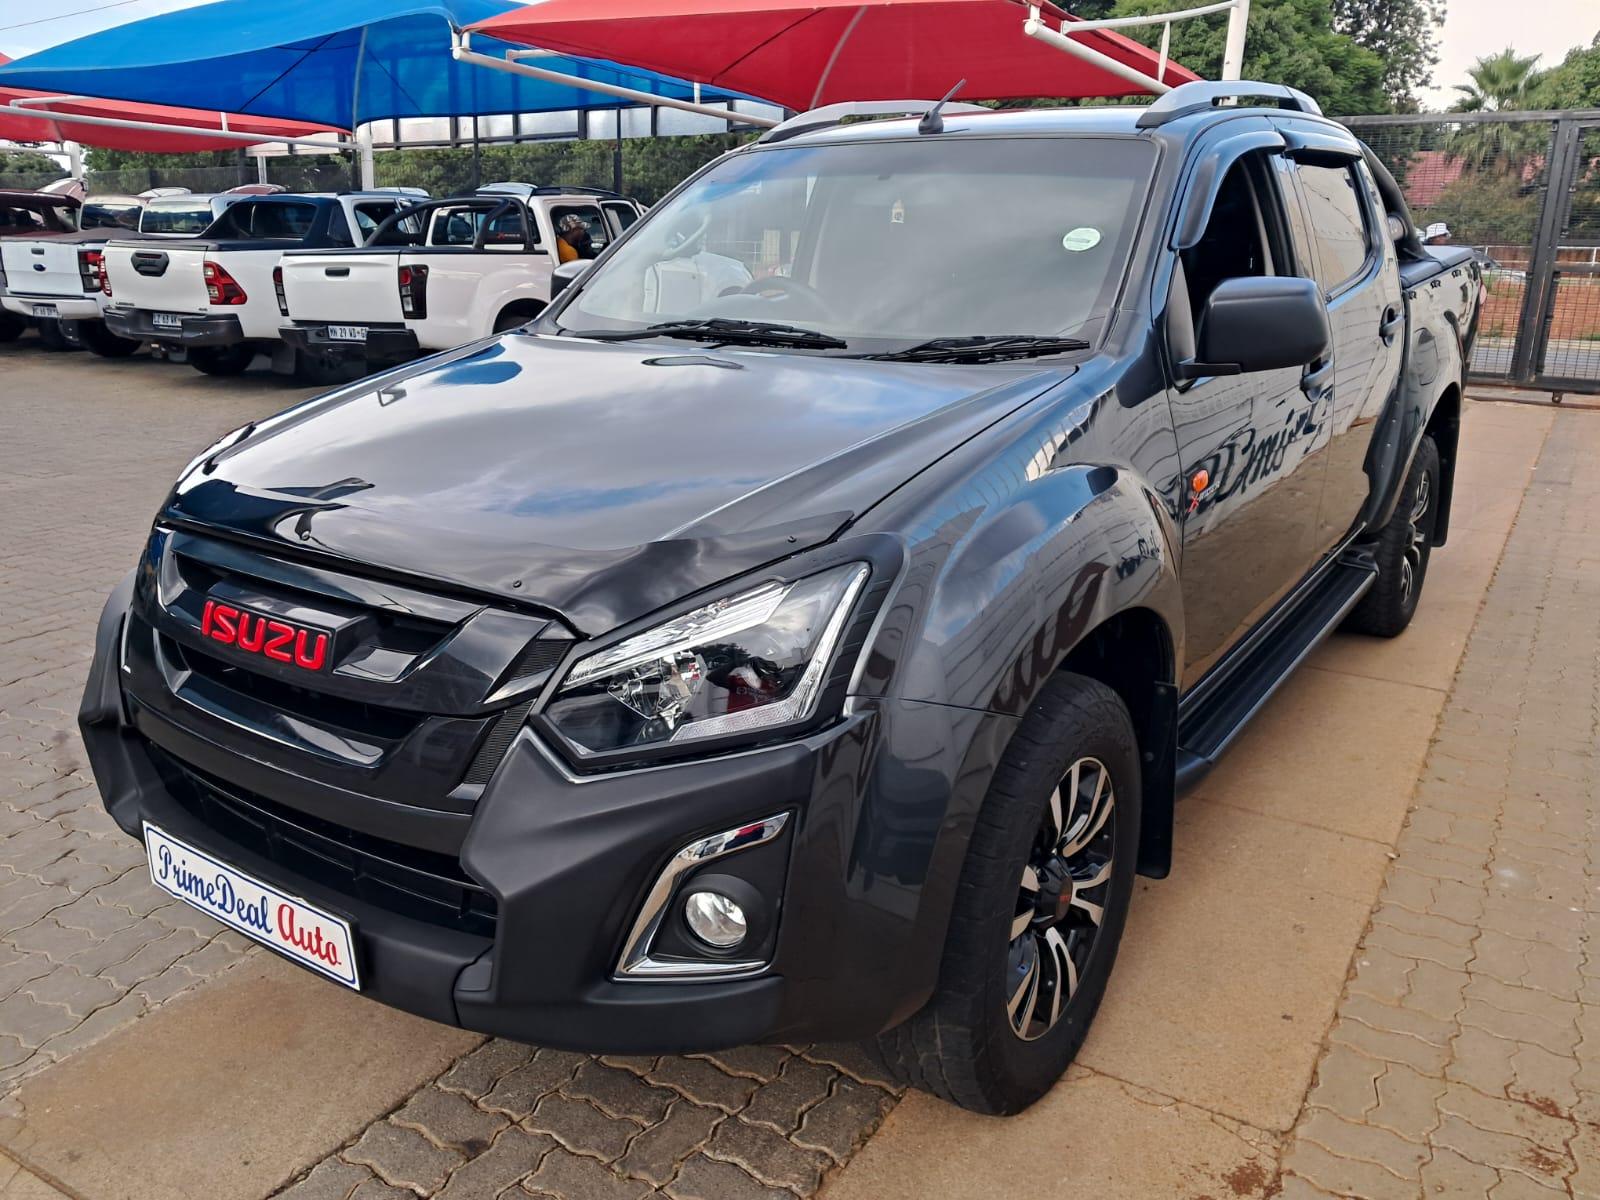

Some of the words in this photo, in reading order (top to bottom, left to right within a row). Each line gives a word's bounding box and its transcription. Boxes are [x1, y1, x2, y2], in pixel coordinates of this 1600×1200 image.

[201, 600, 327, 670] ISUZU
[159, 845, 273, 934] PrimeDeal
[277, 903, 342, 966] Auto
